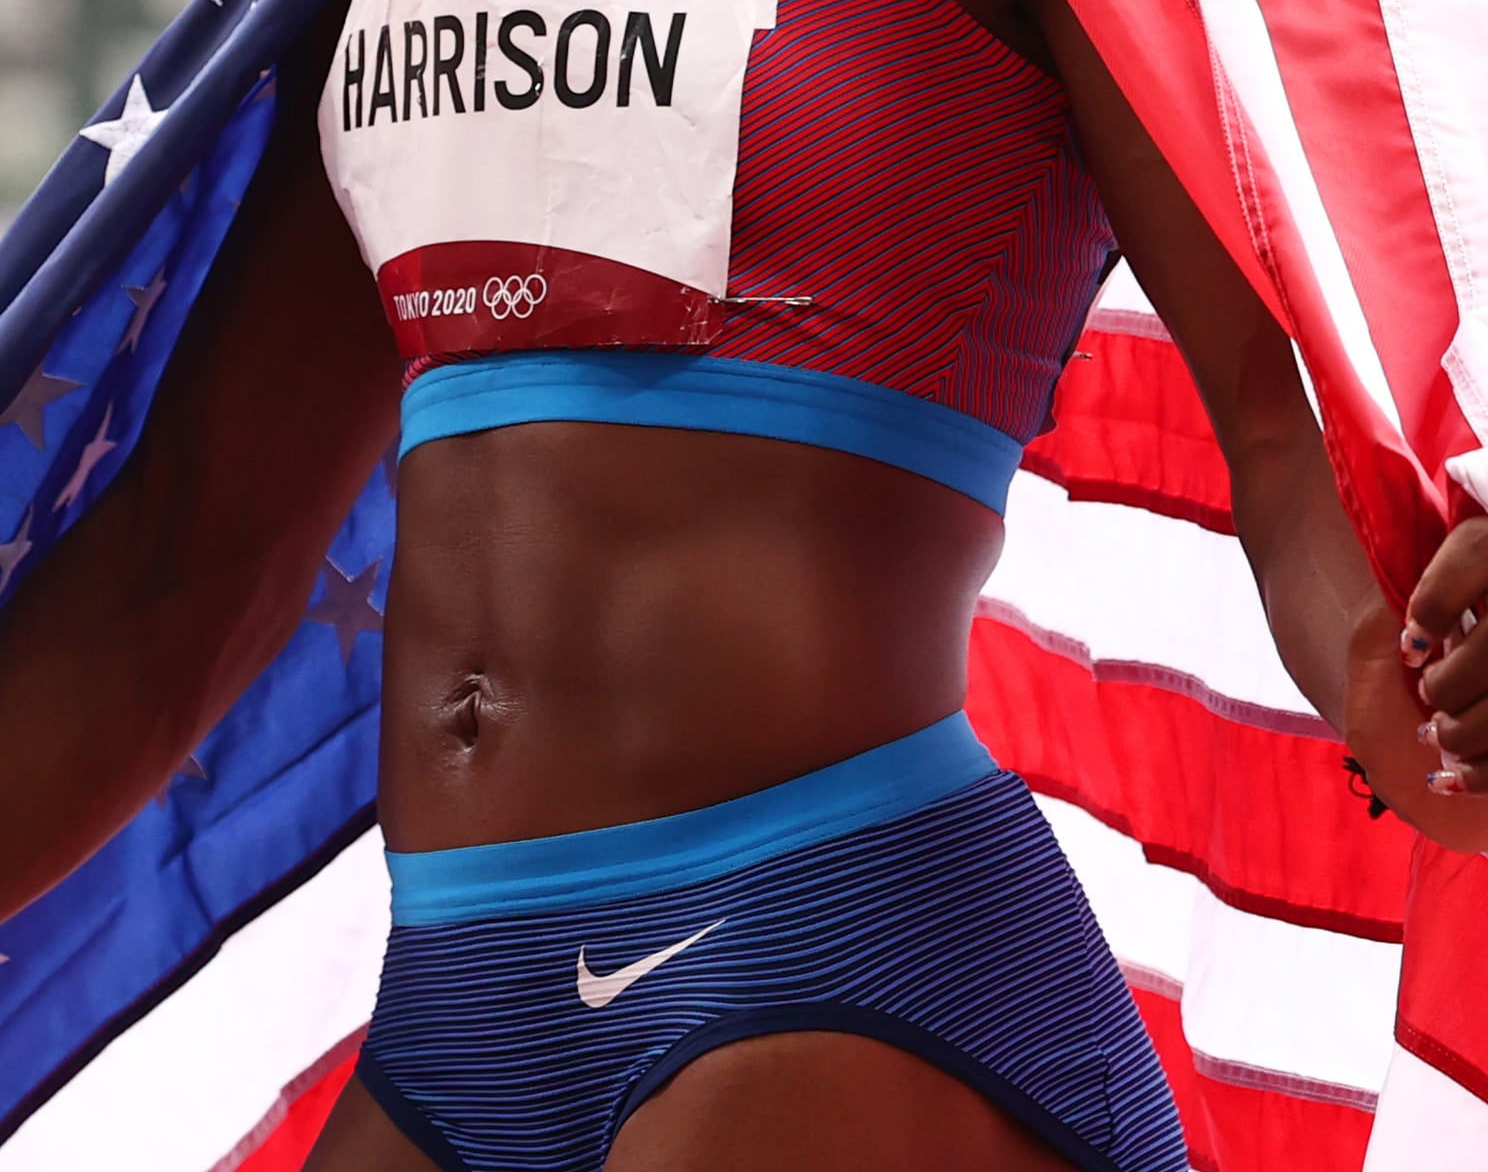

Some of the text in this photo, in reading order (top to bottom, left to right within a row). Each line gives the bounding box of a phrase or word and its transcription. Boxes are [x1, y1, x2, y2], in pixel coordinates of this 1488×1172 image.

[342, 9, 687, 131] HARRISON
[393, 286, 477, 321] TOKYO 2020
